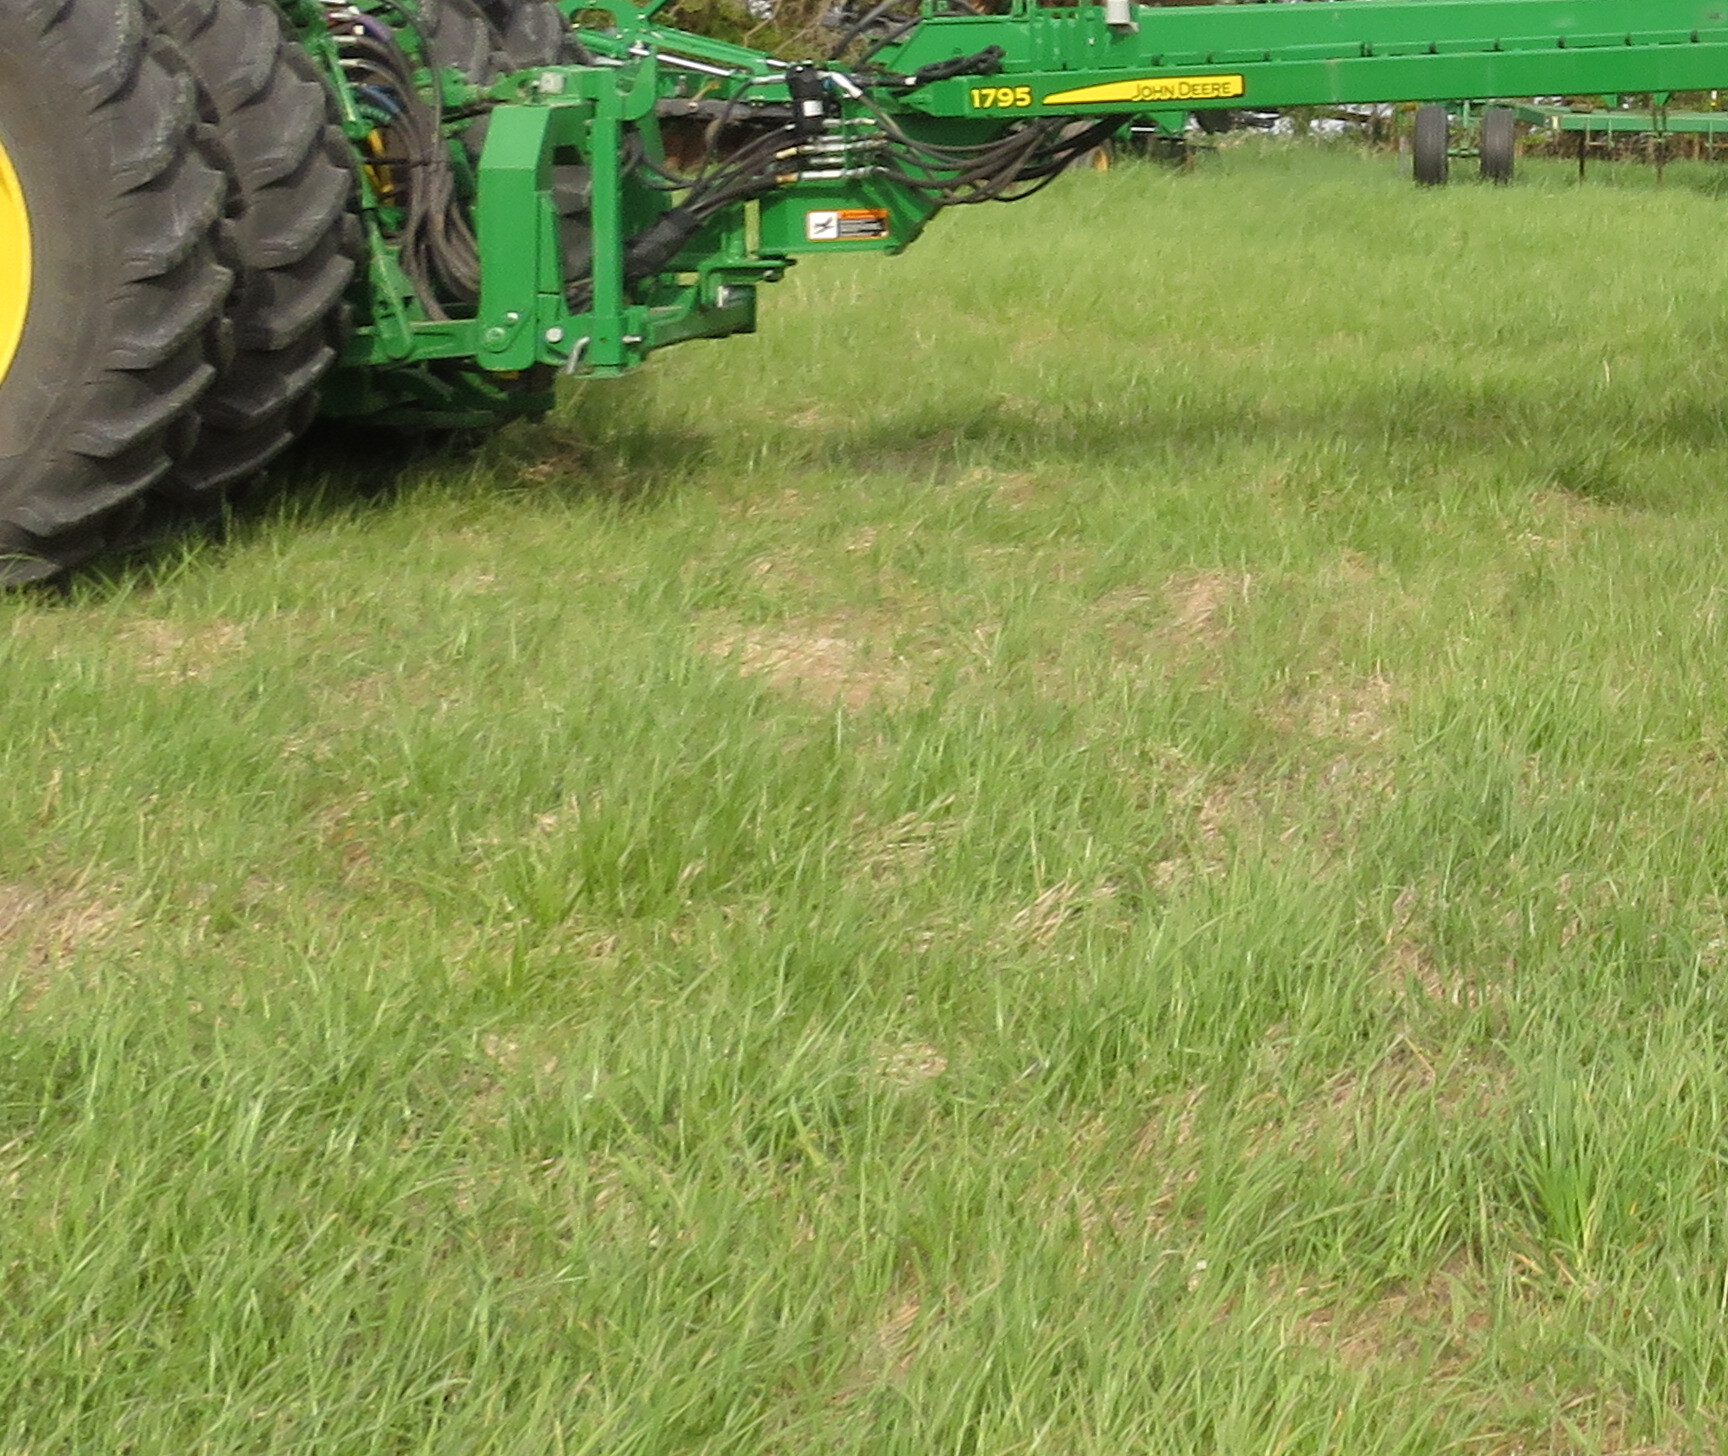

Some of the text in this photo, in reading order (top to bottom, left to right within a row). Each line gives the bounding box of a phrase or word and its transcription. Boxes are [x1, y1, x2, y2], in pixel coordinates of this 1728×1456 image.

[970, 82, 1231, 109] 1795 JOHN DEERE
